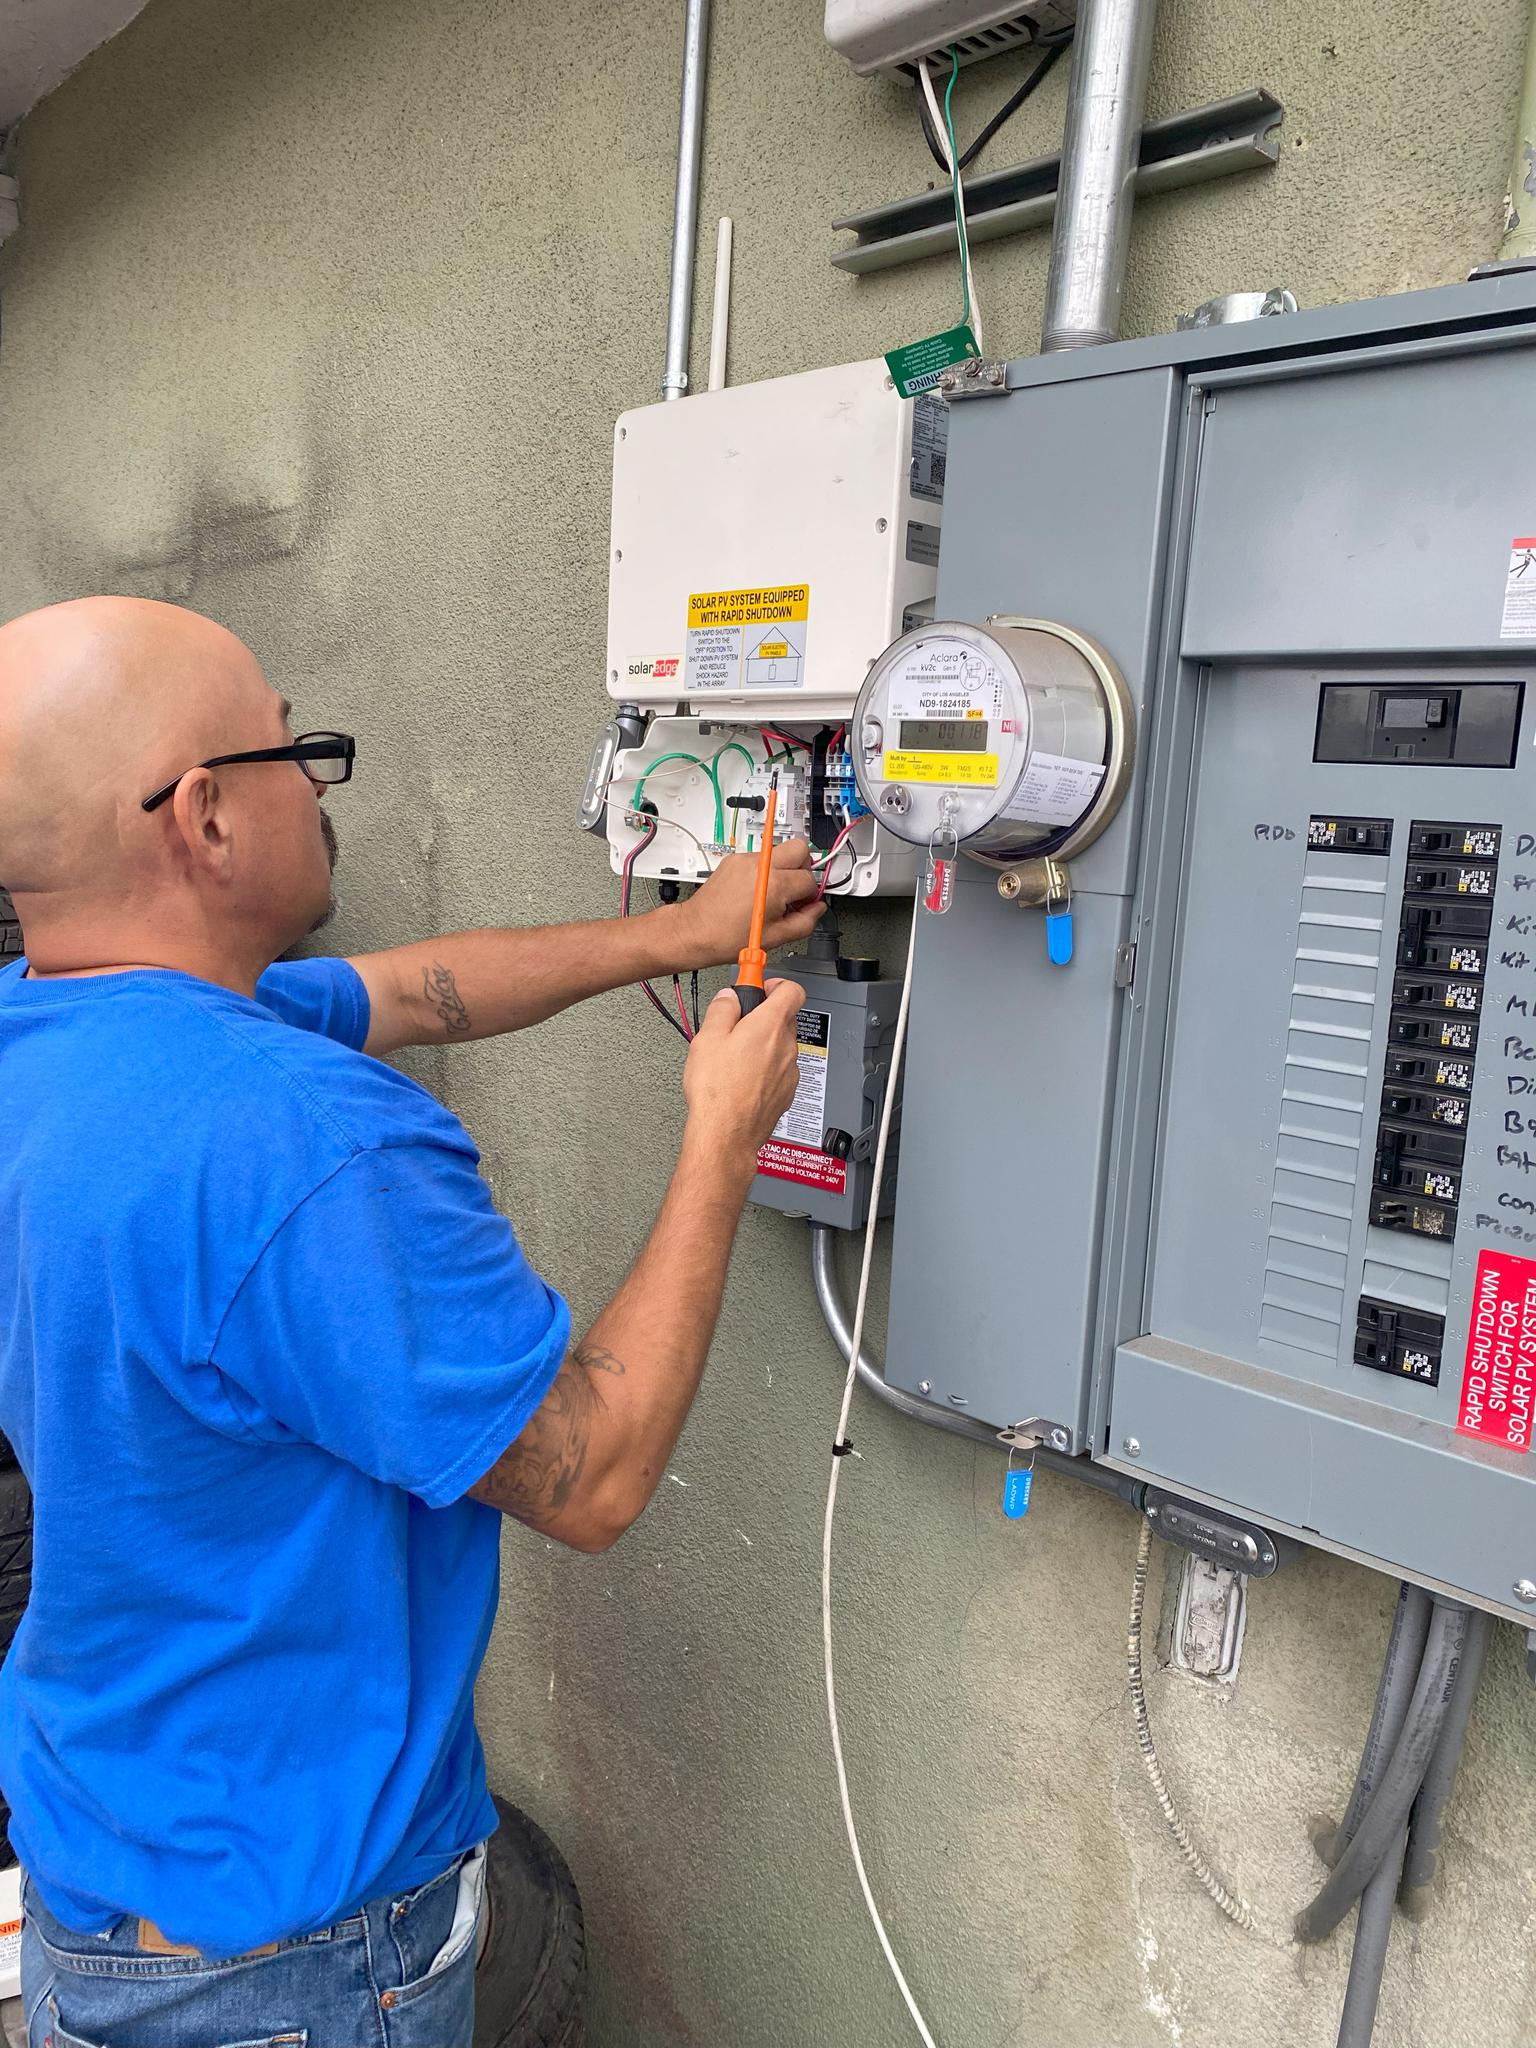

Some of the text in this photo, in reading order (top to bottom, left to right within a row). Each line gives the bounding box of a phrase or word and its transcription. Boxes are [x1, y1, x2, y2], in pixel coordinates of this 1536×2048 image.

[908, 370, 944, 390] RNING
[691, 589, 805, 609] SOLAR PV SYSTEM EQUIPPED
[700, 606, 792, 623] WITH RAPID SHUTDOWN
[702, 629, 714, 637] RAPID
[715, 628, 740, 636] SHUTDOWN
[930, 653, 959, 663] Aclara
[628, 660, 678, 677] solaredge
[711, 671, 728, 679] HAZARD
[919, 699, 971, 708] ND9-1824185
[925, 873, 933, 894] DWP
[1500, 951, 1530, 968] Kit
[804, 1031, 822, 1039] GENERAL
[764, 1152, 796, 1165] OPERATING
[795, 1158, 823, 1171] CURRENT
[827, 1166, 846, 1176] 21.00A
[781, 1146, 791, 1156] AC
[791, 1148, 833, 1165] DISCONNECT
[764, 1161, 796, 1174] OPERATING
[795, 1167, 820, 1180] VOLTAGE
[825, 1175, 840, 1185] 240V
[1464, 1269, 1501, 1430] RAPID SHUTDOWN
[1488, 1299, 1520, 1412] SWITCH FOR
[1506, 1277, 1536, 1445] SOLAR PV SYSTEM
[1009, 1477, 1019, 1510] LADWP
[1441, 1657, 1460, 1704] CENTAUR
